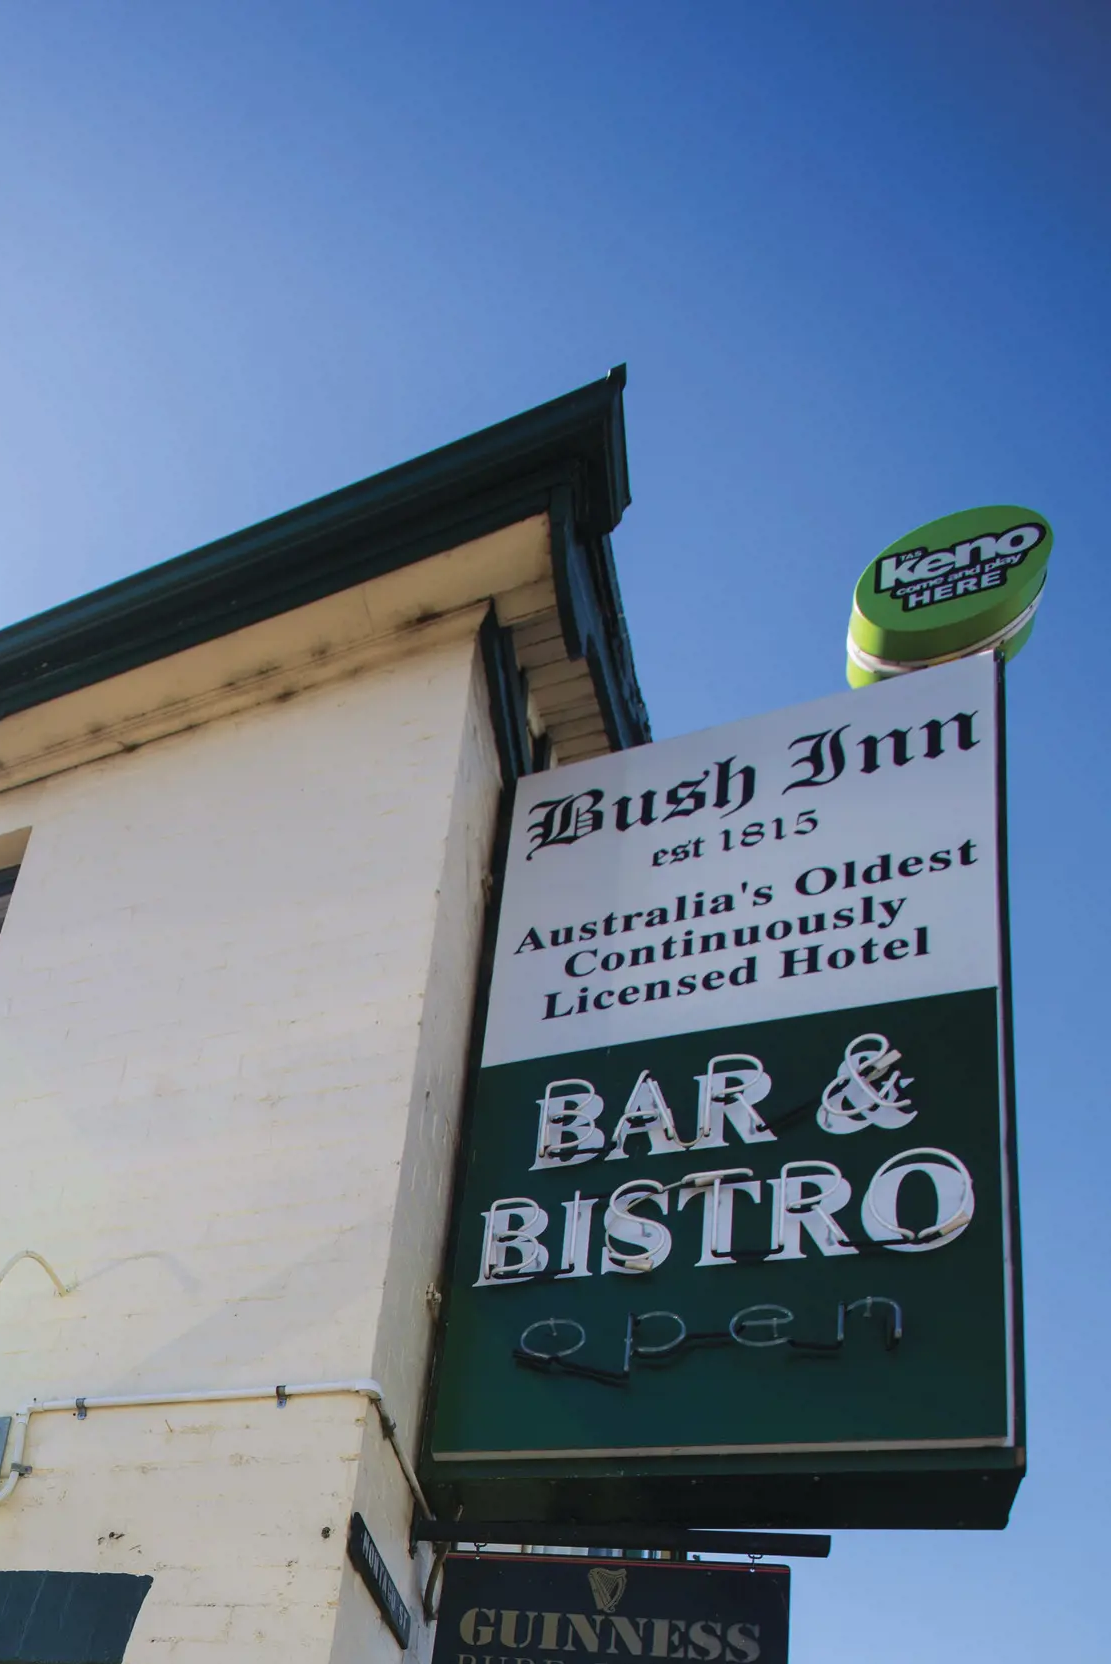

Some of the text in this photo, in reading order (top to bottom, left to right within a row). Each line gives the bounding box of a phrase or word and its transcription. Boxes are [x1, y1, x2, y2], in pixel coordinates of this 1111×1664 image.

[896, 553, 1022, 596] come and play
[901, 550, 923, 562] TAS
[907, 570, 1001, 609] HERE
[525, 709, 981, 861] Bush Inn
[652, 809, 820, 868] est 1815
[513, 838, 979, 955] Australia's Oldest
[564, 895, 908, 978] Continuously
[542, 926, 931, 1021] Licensed Hotel
[528, 1033, 919, 1171] BAR &
[472, 1147, 976, 1288] BISTRO
[397, 1604, 408, 1630] ST
[459, 1607, 762, 1664] GUINNESS
